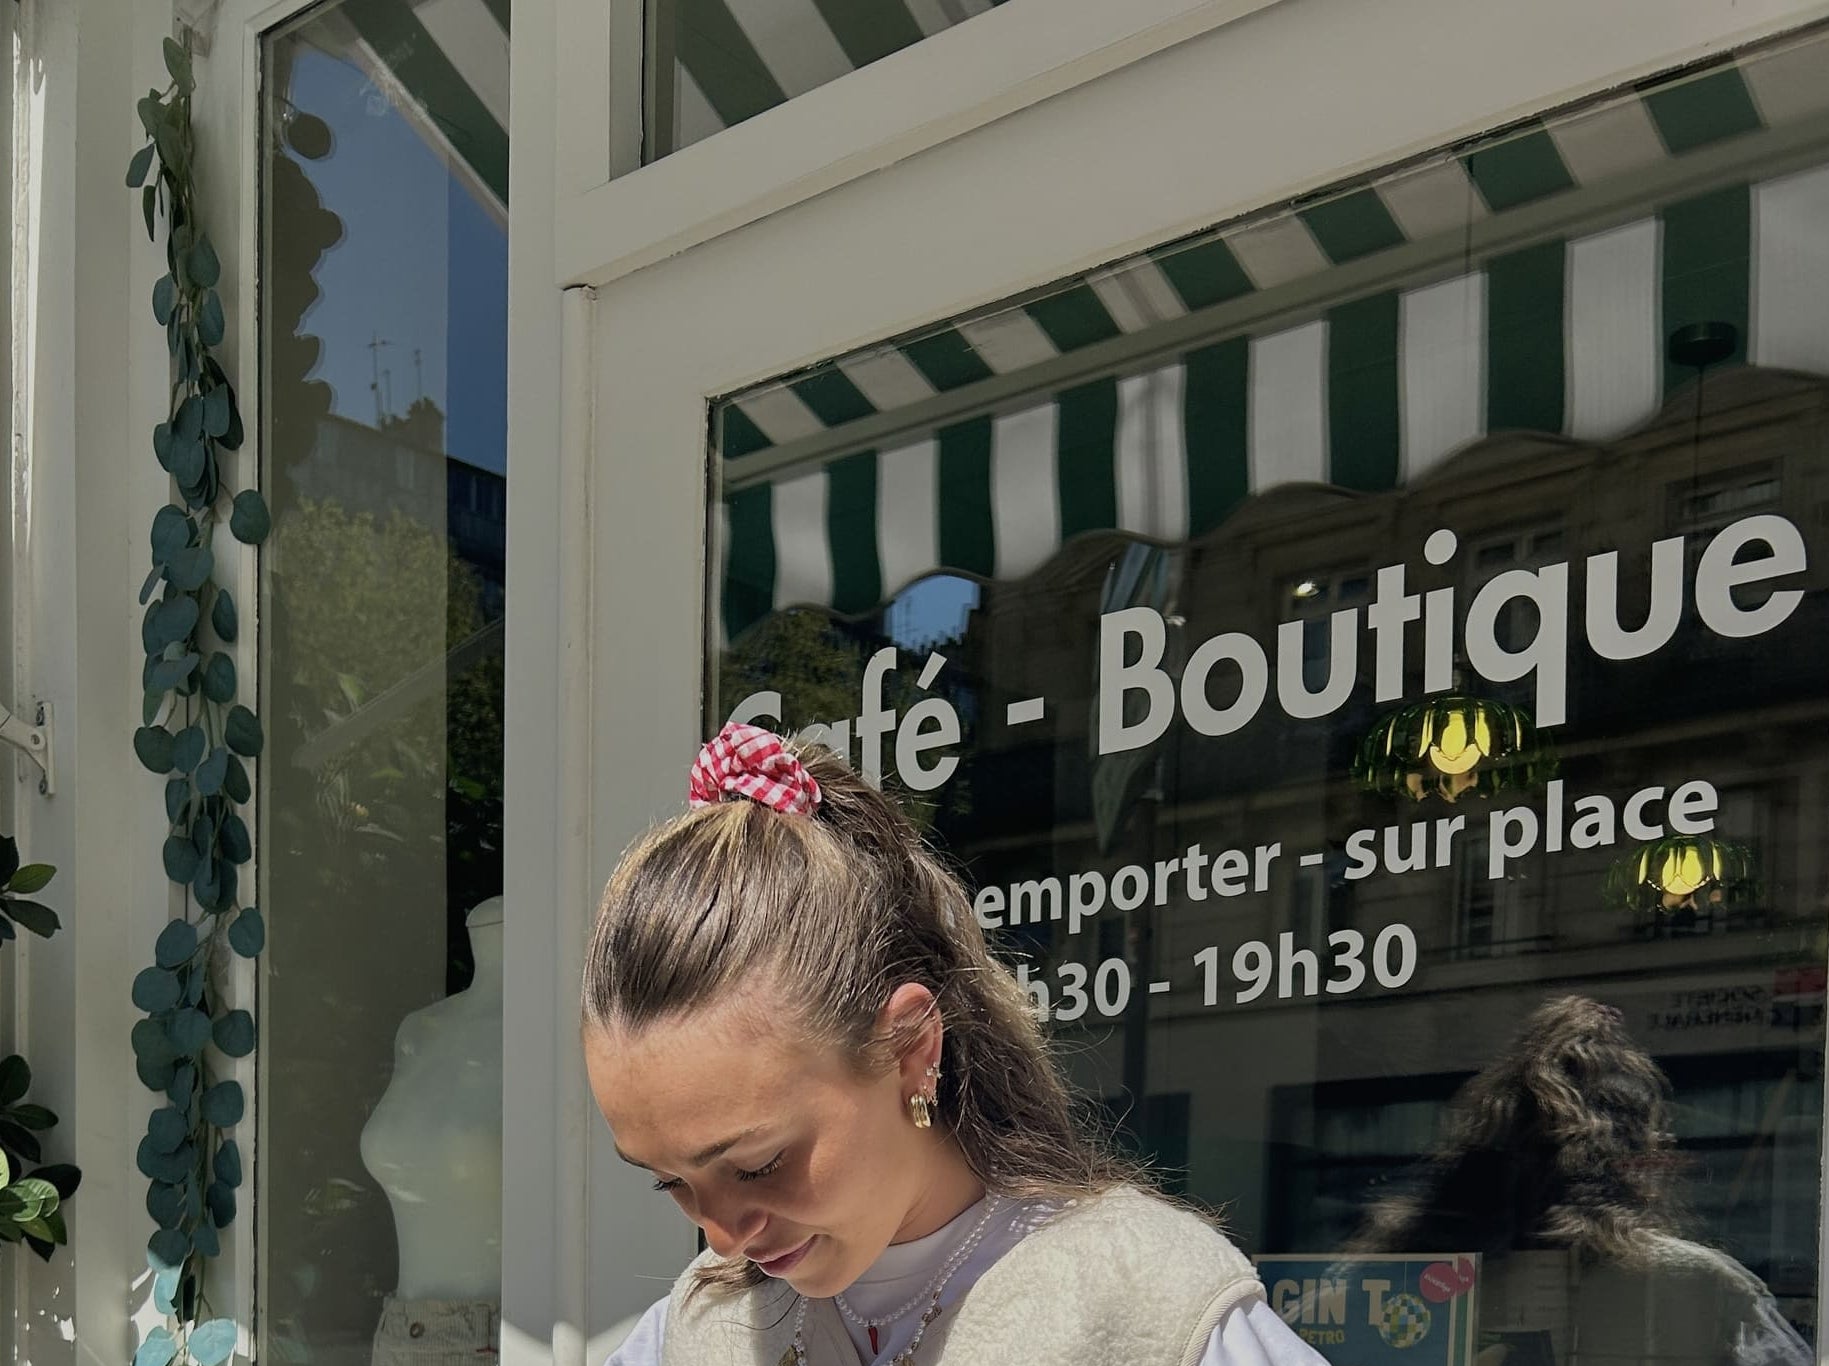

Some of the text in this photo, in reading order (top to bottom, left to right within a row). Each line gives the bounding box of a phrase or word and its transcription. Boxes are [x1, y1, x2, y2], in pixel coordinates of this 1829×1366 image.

[1099, 514, 1807, 755] Boutique
[974, 842, 1281, 934] emporter
[1344, 814, 1465, 880] sur
[1488, 780, 1719, 880] place
[1016, 957, 1131, 1022] h30
[1193, 923, 1417, 1006] 19h30
[1272, 1279, 1347, 1325] GIN
